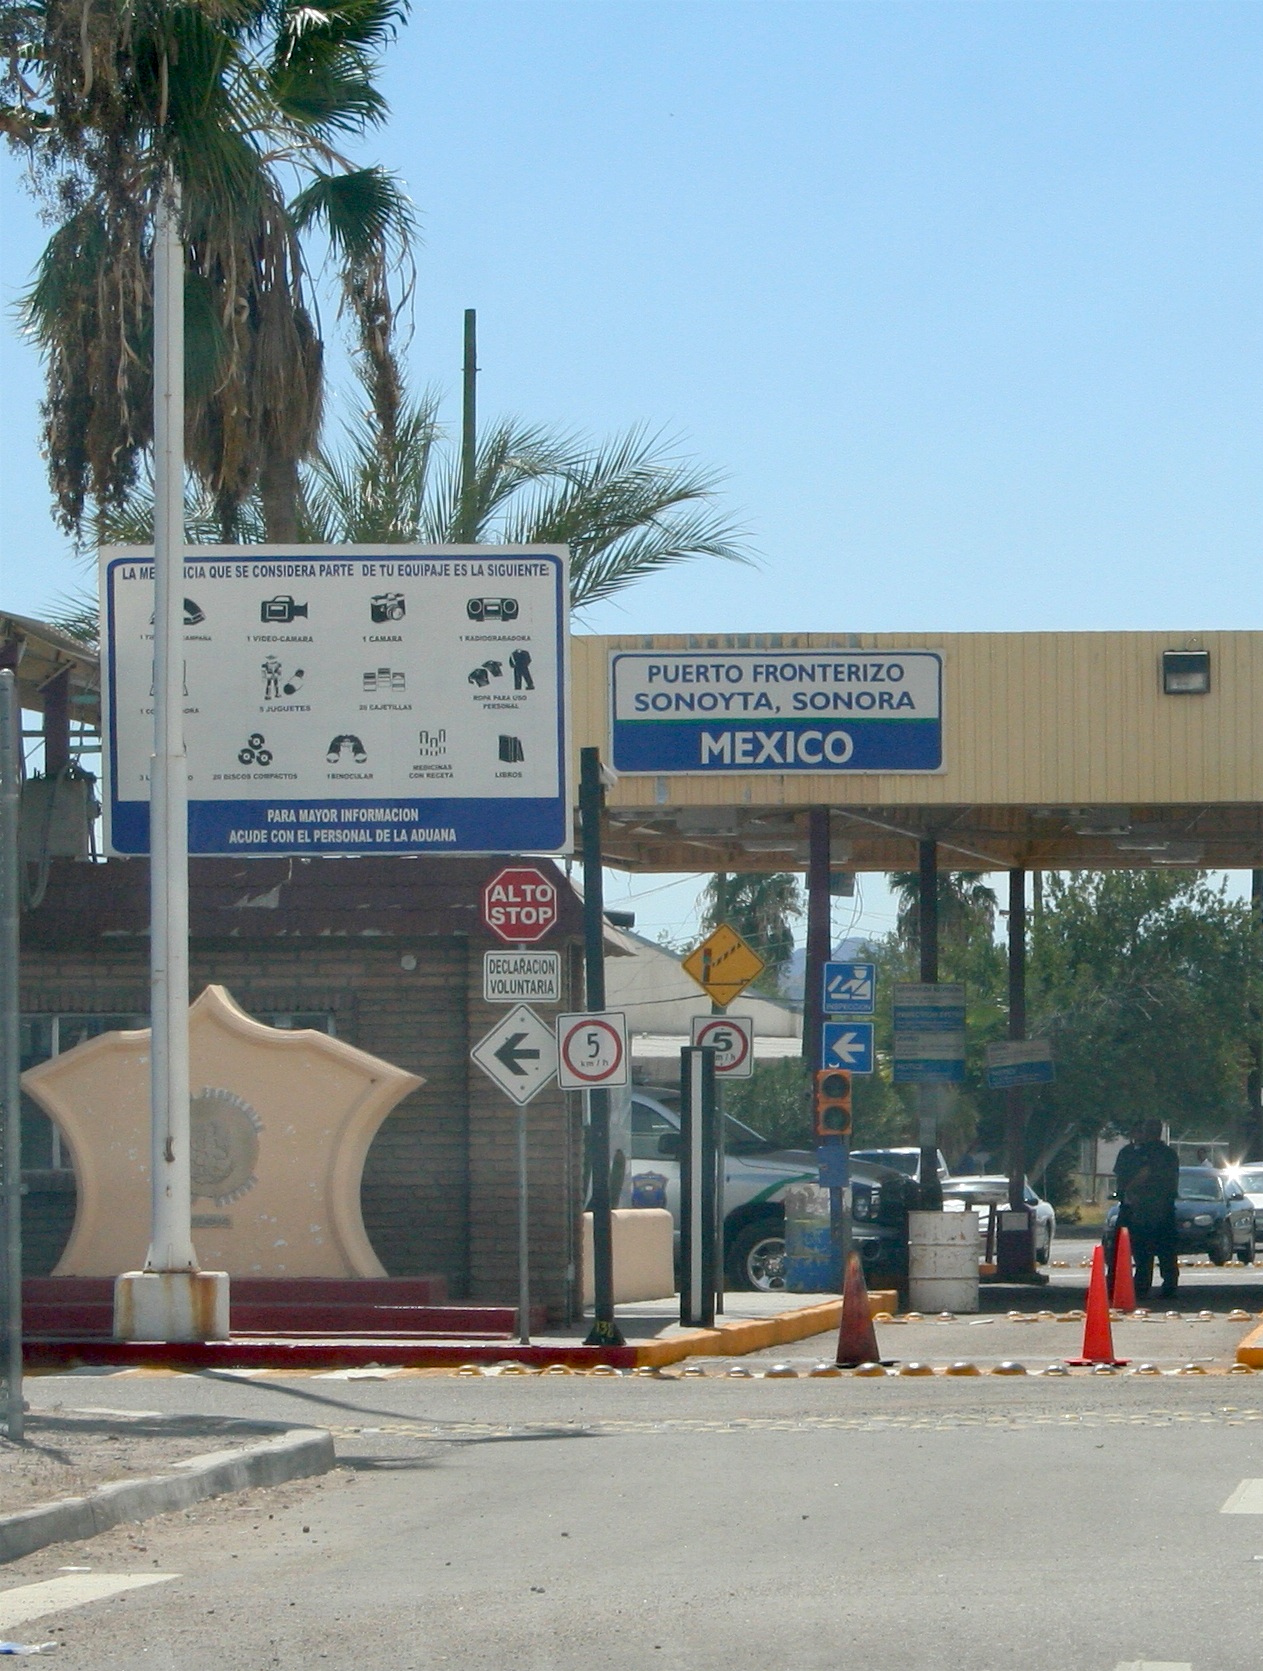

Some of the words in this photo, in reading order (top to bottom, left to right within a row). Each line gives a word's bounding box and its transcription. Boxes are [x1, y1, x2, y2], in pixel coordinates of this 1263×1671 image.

[122, 567, 136, 580] LA
[139, 566, 206, 580] MECIA
[209, 565, 232, 579] QUE
[235, 564, 249, 579] SE
[252, 564, 316, 579] CONSIDERA
[319, 563, 354, 578] PARTE
[362, 563, 376, 577] DE
[379, 563, 394, 577] TU
[399, 563, 450, 577] EQUIPAJE
[454, 563, 468, 577] ES
[471, 563, 484, 577] LA
[648, 663, 743, 684] PUERTO
[753, 663, 905, 683] FRONTERIZO
[265, 704, 311, 713] JUGUETES
[634, 691, 781, 713] SONOYTA,
[792, 691, 916, 711] SONORA
[700, 730, 854, 765] MEXICO
[267, 809, 296, 823] PARA
[299, 809, 338, 823] MAYOR
[341, 808, 419, 822] INFORMACION
[229, 829, 268, 844] ACUDE
[270, 829, 294, 843] CON
[297, 829, 311, 843] EL
[313, 829, 373, 843] PERSONAL
[375, 828, 390, 842] DE
[393, 828, 408, 842] LA
[410, 828, 457, 842] ADUANA
[490, 884, 553, 903] ALTO
[490, 906, 553, 925] STOP
[489, 958, 555, 976] DECLARACION
[490, 979, 554, 996] VOLUNTARIA
[587, 1032, 600, 1058] 5
[712, 1032, 733, 1051] 5
